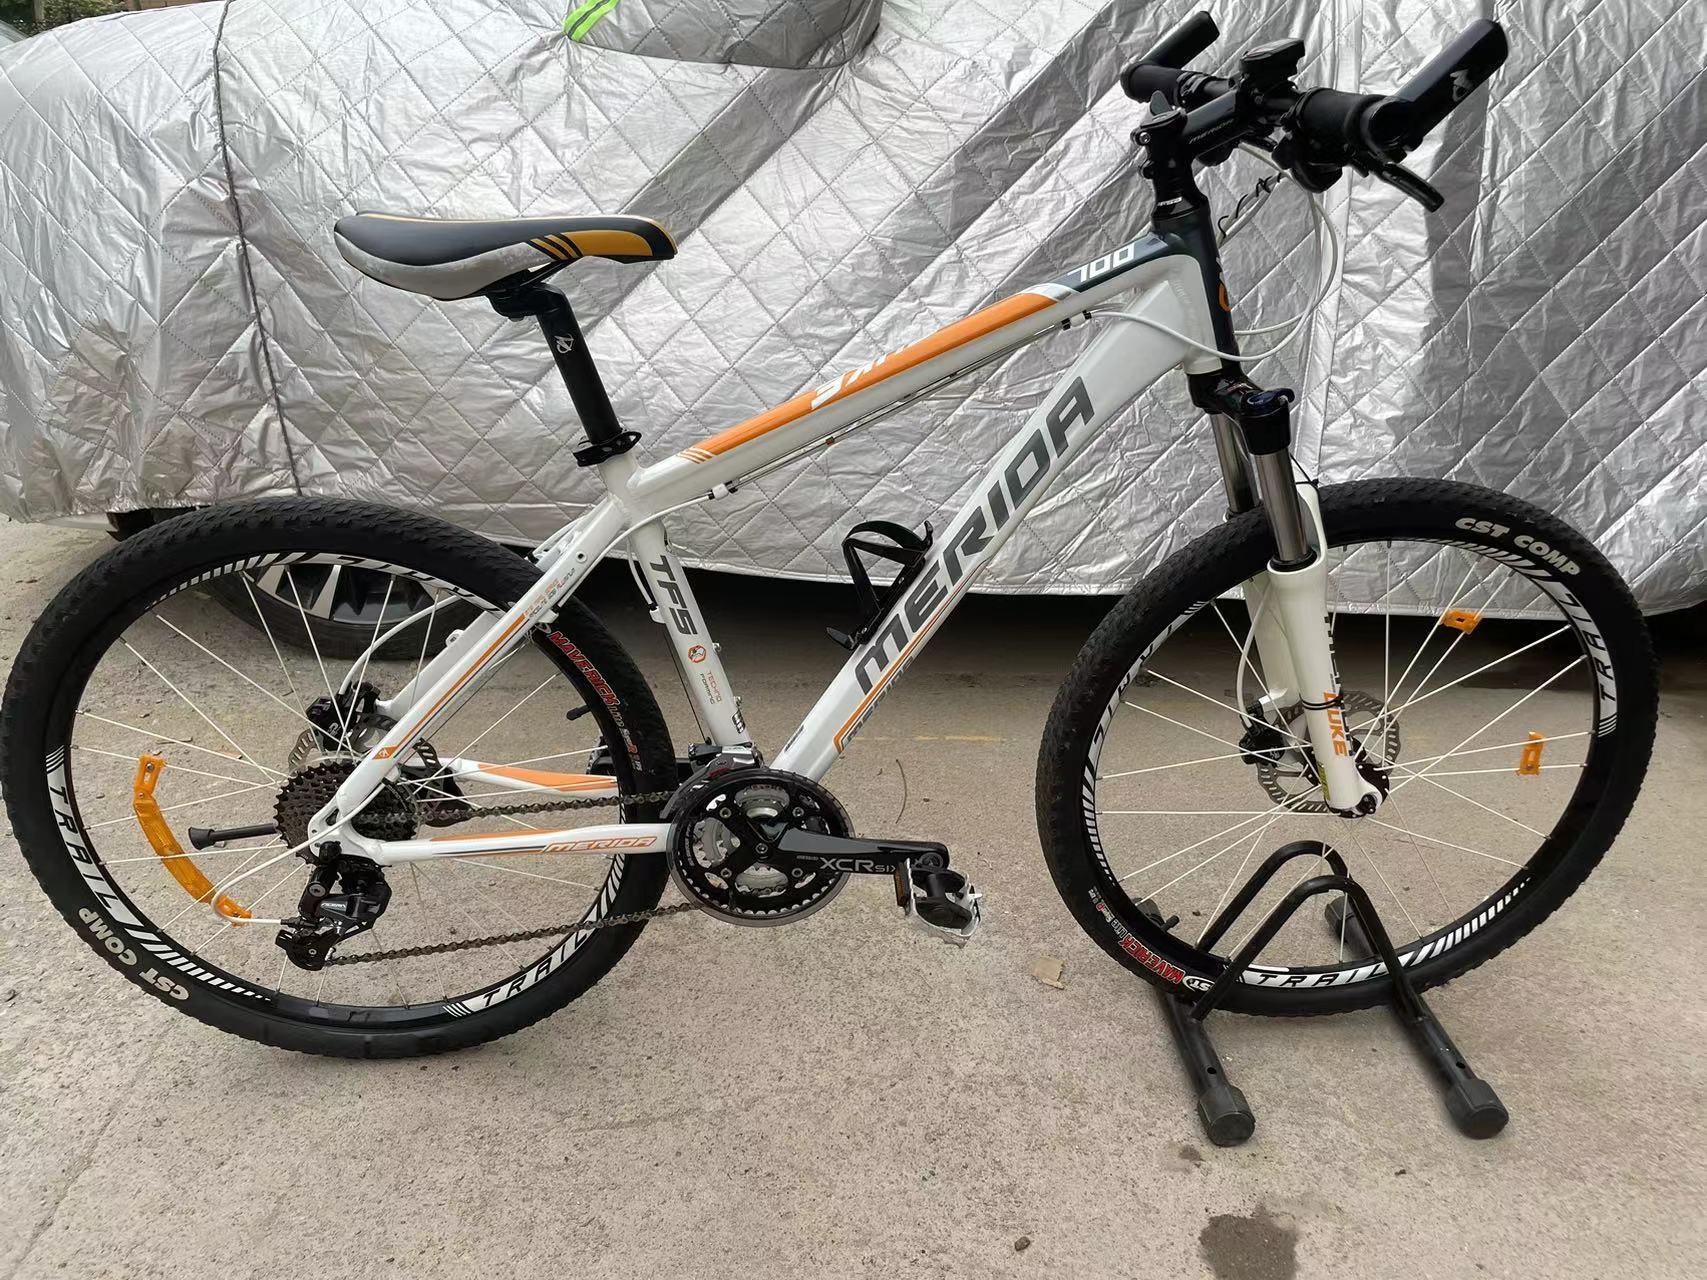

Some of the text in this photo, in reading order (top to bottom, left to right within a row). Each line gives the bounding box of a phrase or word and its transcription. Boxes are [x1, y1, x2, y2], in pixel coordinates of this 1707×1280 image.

[1066, 242, 1135, 282] 700
[854, 375, 1096, 696] MERIDA
[1454, 517, 1581, 575] CST COMP
[649, 554, 699, 636] TFS
[549, 630, 621, 707] MAVERICK
[1558, 592, 1616, 702] TRAIL
[49, 785, 119, 910] TRAIL
[542, 836, 658, 853] MERIDA
[820, 857, 875, 872] XCR
[78, 907, 190, 1001] CST COMP
[483, 929, 588, 1008] TRAIL
[1117, 932, 1187, 985] MAVERICK
[1257, 964, 1388, 988] TRAIL
